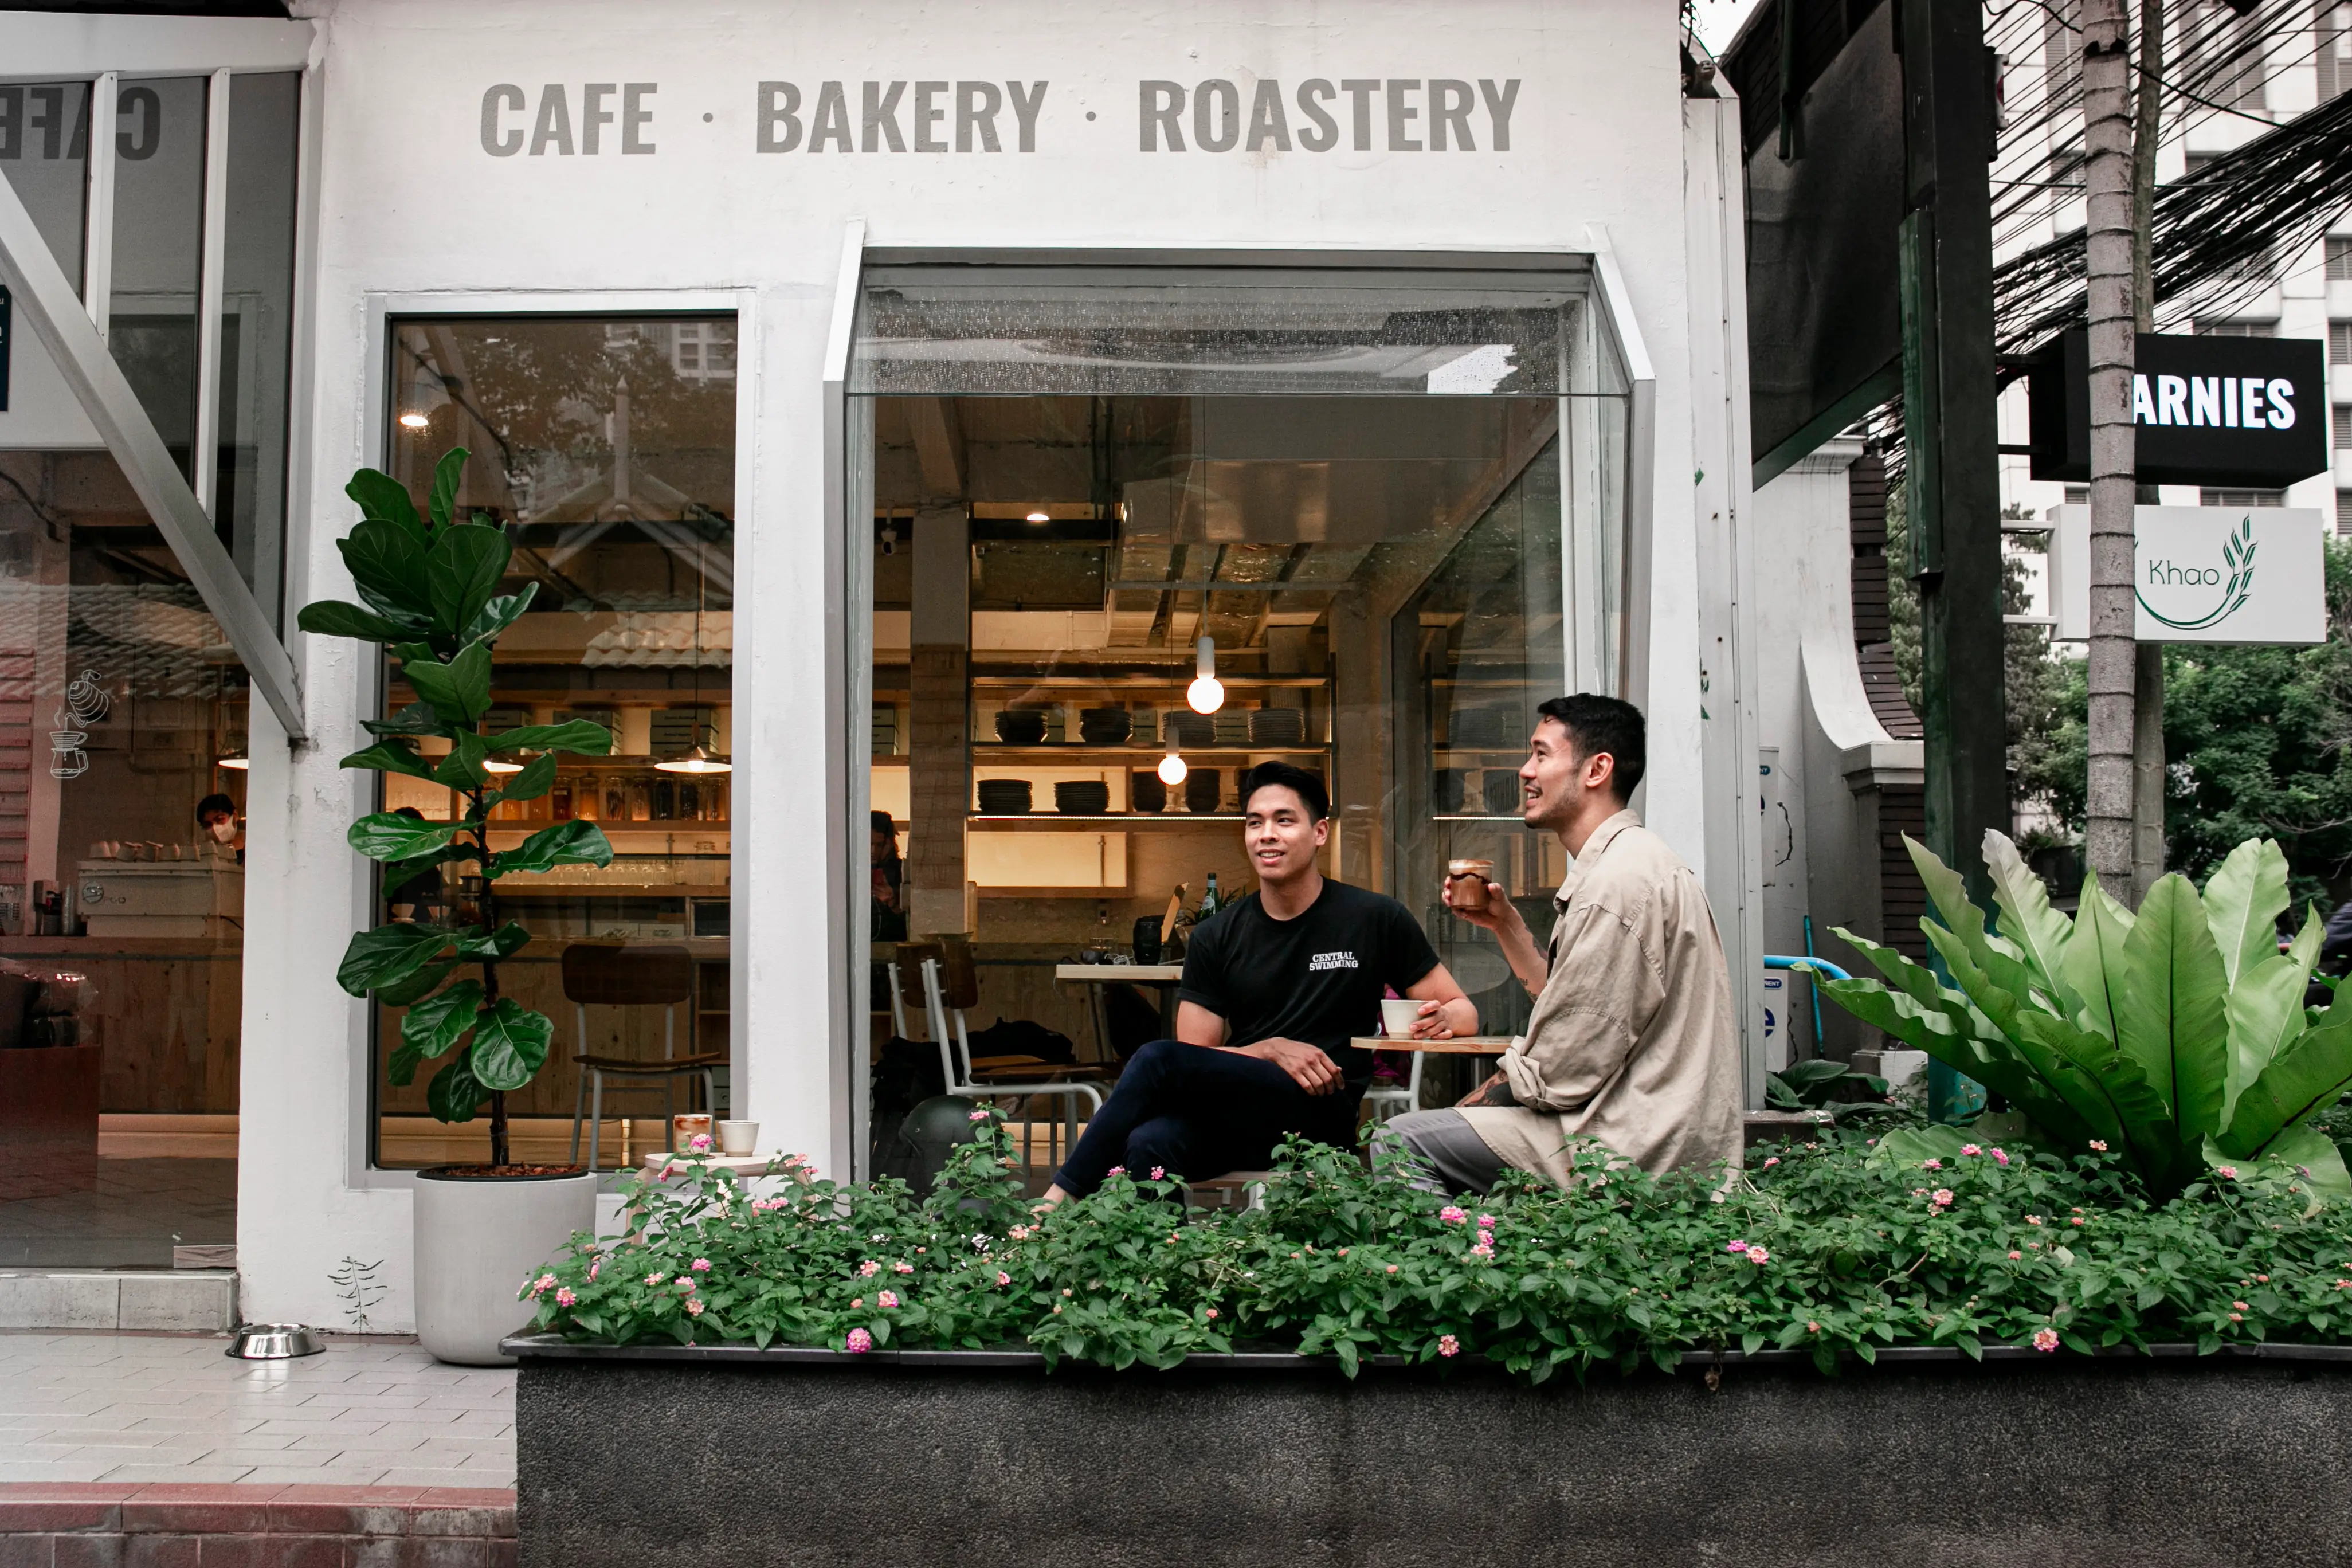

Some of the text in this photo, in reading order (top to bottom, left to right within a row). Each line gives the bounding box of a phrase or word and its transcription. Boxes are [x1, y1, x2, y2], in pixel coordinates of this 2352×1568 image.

[480, 78, 1522, 157] CAFE BAKERY ROASTERY
[2133, 374, 2296, 429] ARNIES
[2149, 559, 2220, 586] Khao
[1309, 959, 1358, 971] SWIMMING
[1312, 951, 1354, 962] CENTRAL
